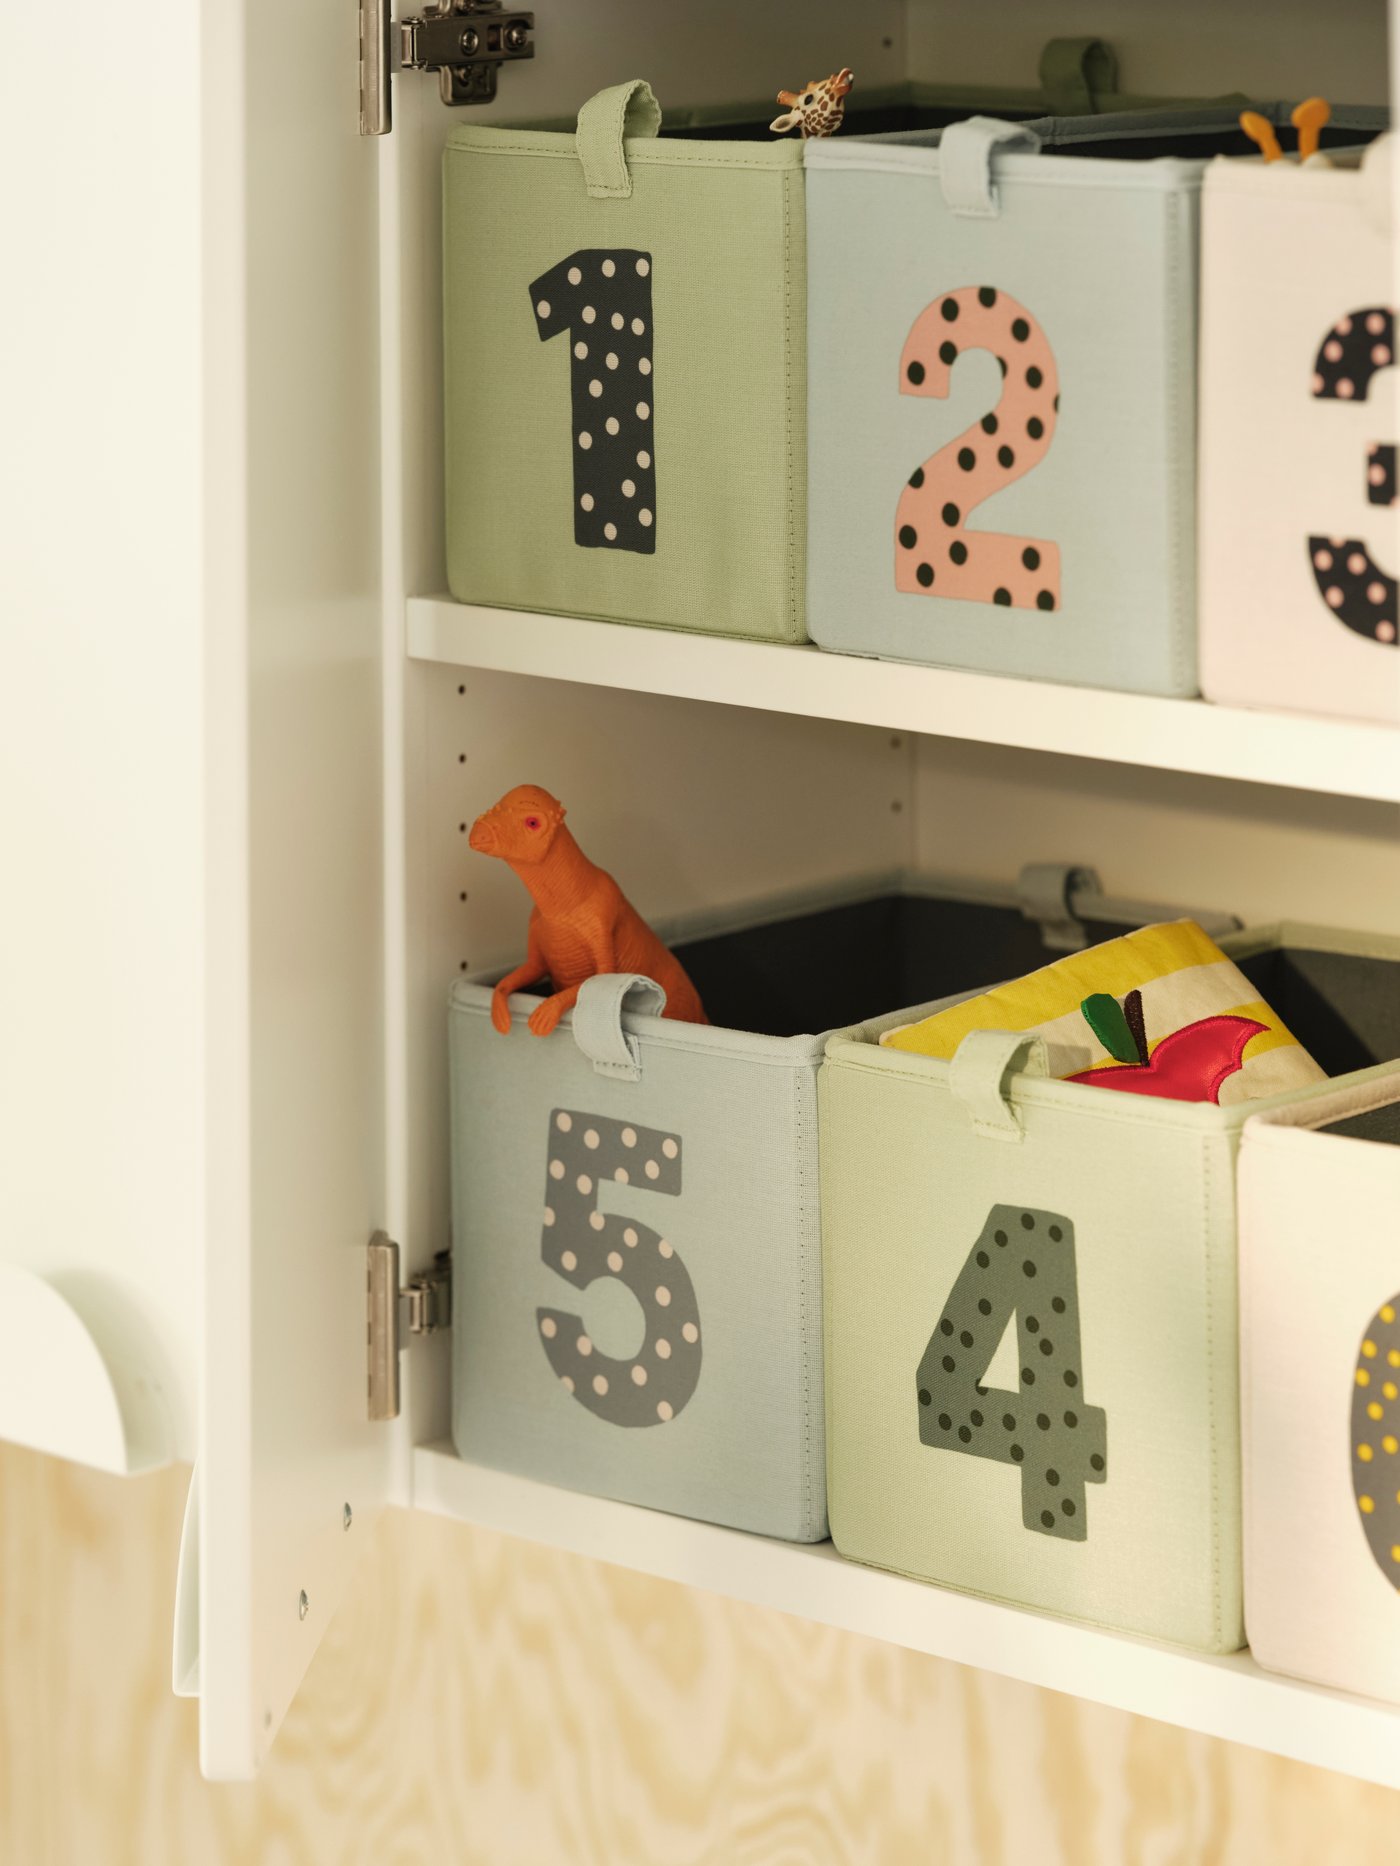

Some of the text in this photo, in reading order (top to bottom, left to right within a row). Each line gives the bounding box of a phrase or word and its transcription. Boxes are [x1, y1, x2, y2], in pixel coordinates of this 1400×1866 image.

[529, 249, 656, 555] 1
[894, 285, 1060, 611] 2
[536, 1108, 702, 1428] 5
[916, 1203, 1107, 1542] 4
